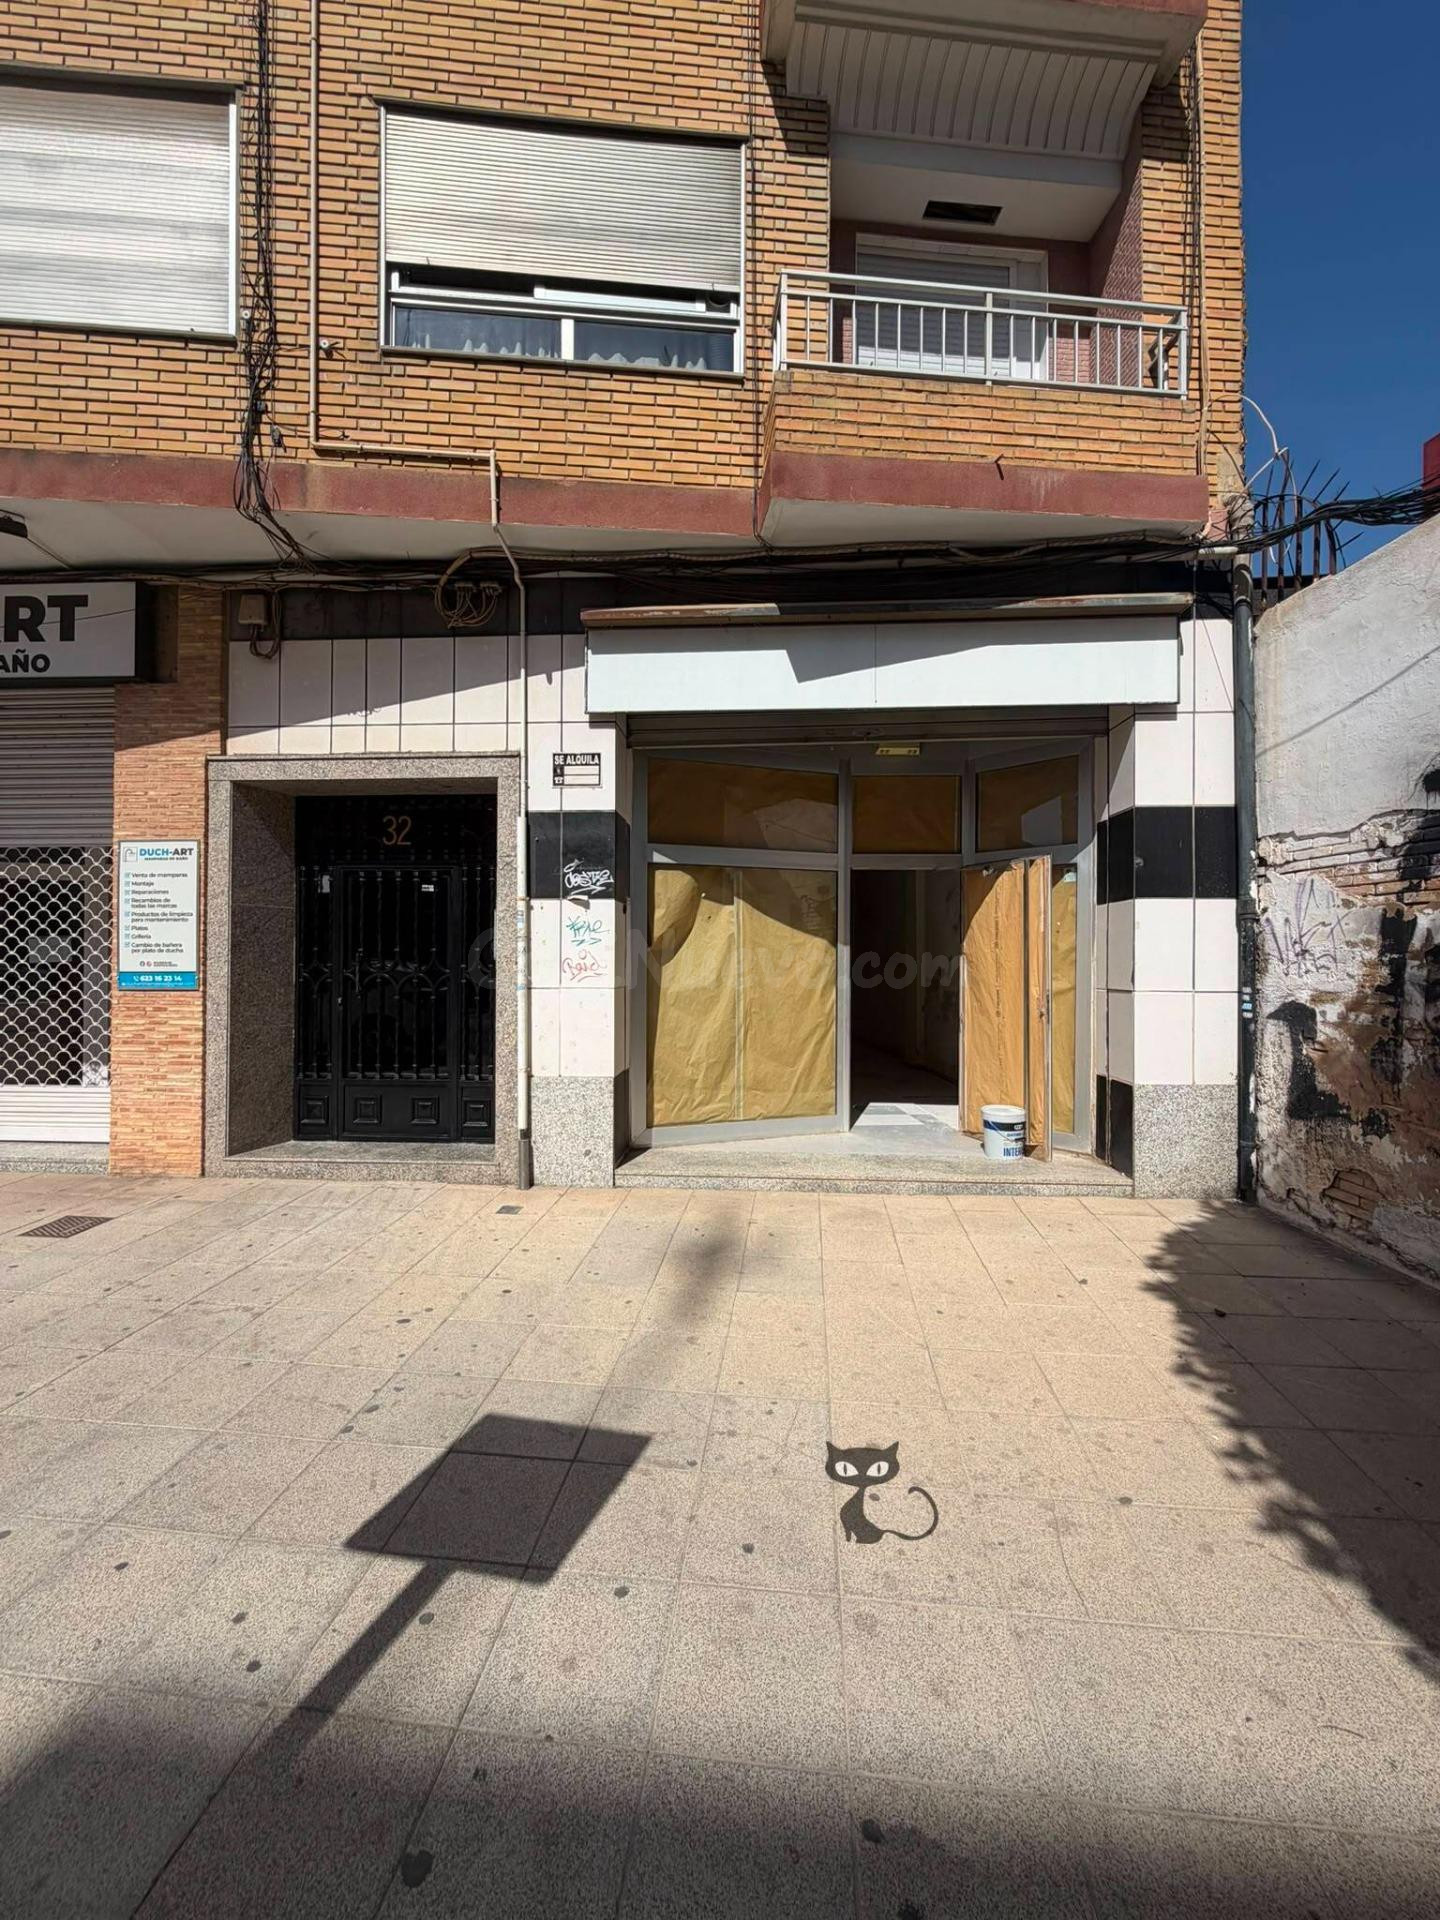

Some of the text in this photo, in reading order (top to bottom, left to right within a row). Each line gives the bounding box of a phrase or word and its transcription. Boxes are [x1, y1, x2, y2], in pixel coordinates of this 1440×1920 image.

[554, 754, 600, 765] SE ALQUILA
[382, 815, 412, 846] 32
[139, 848, 194, 856] DUCH-ART
